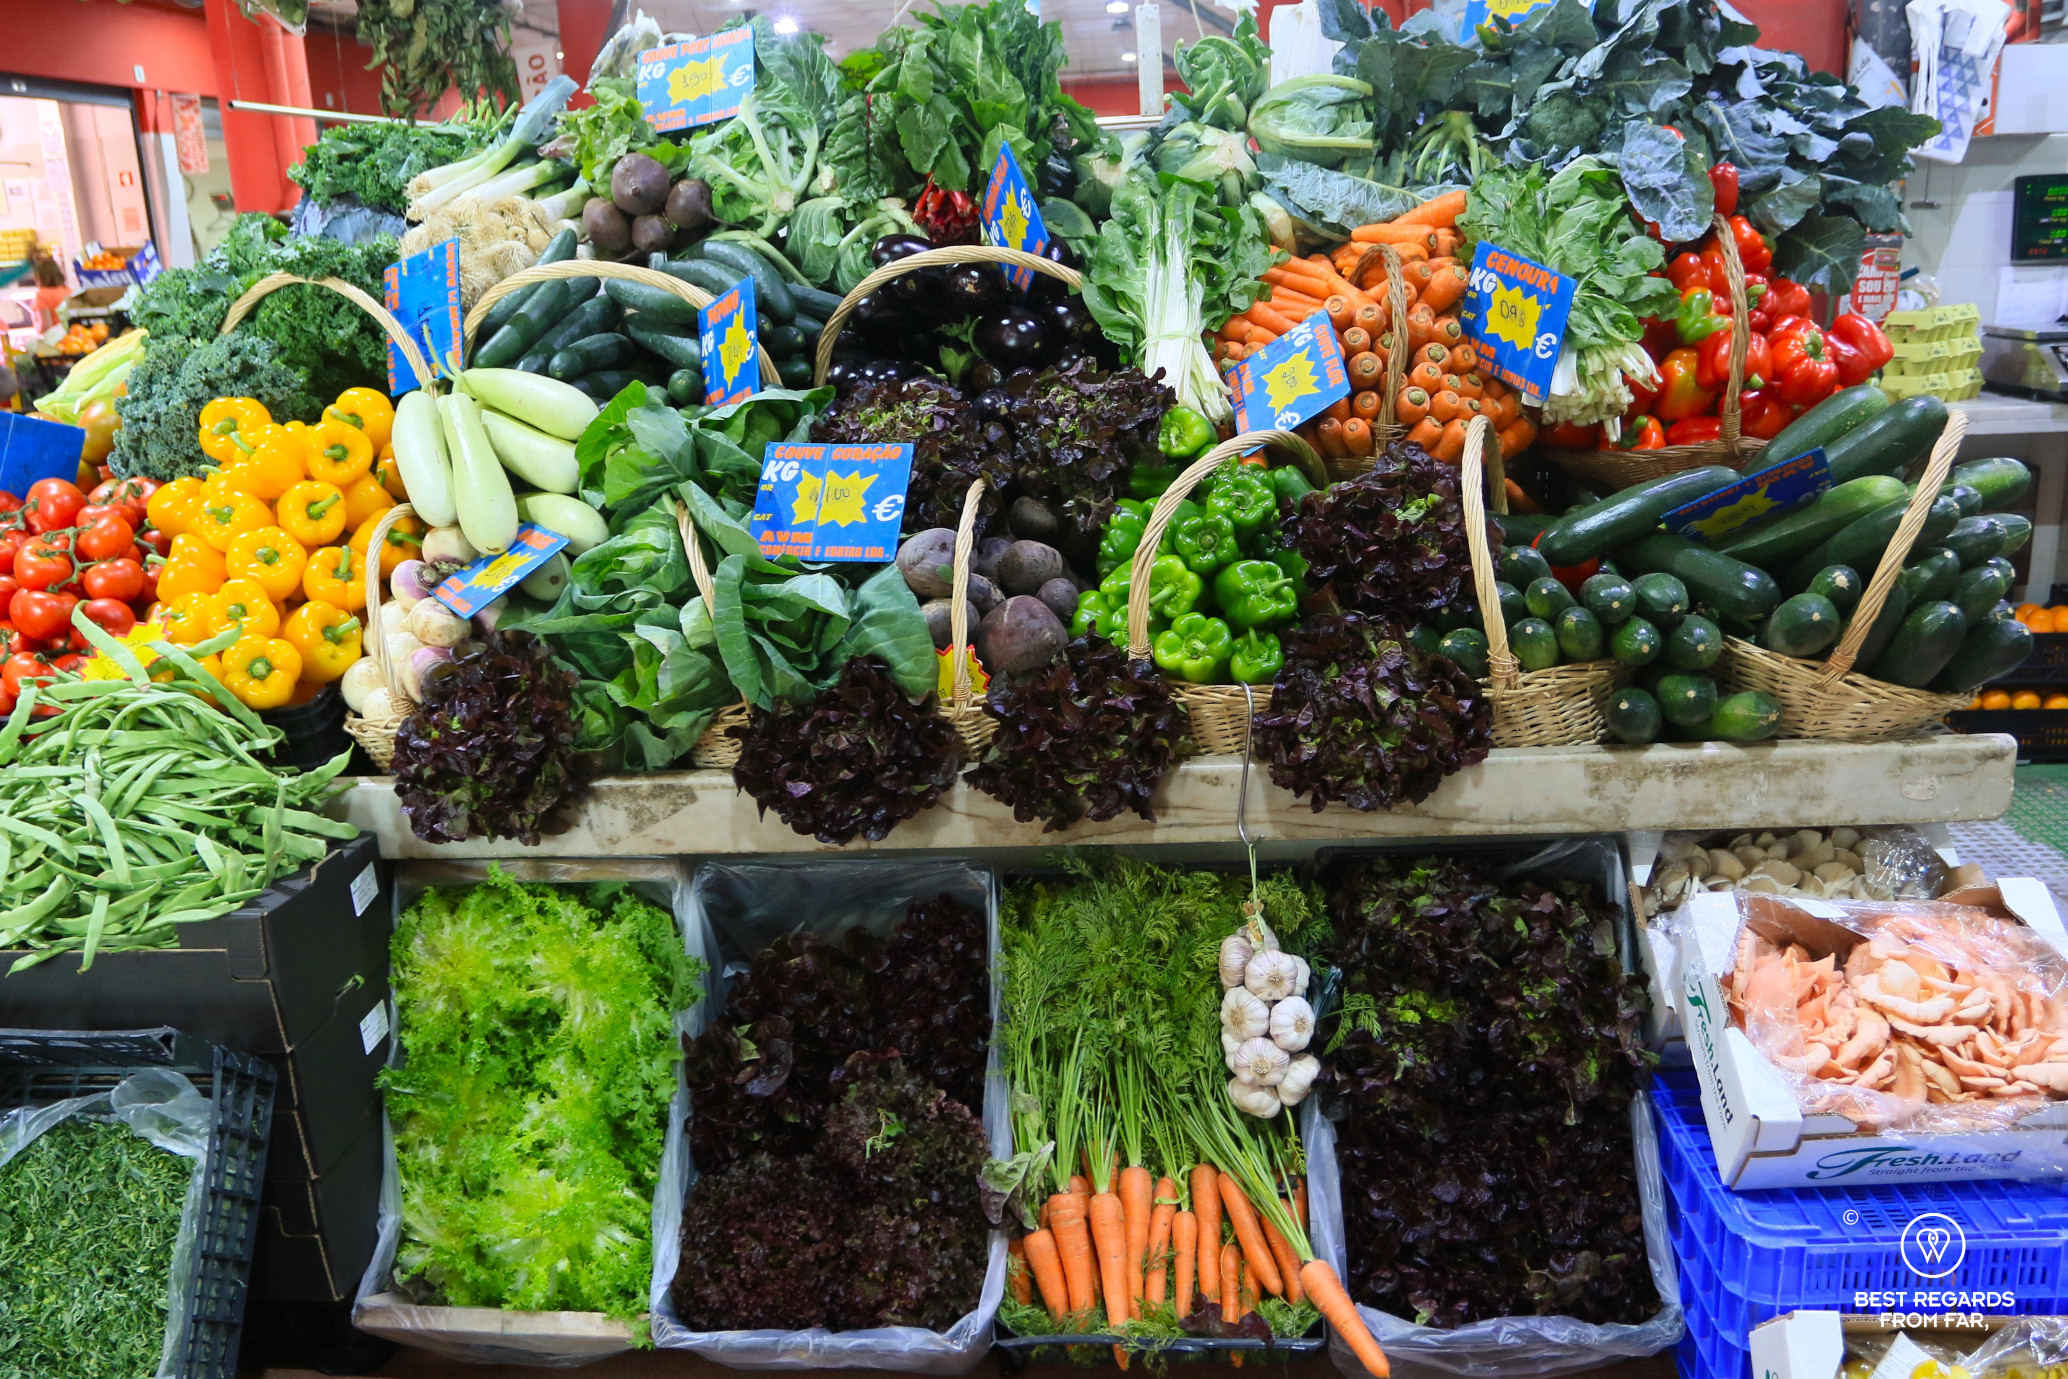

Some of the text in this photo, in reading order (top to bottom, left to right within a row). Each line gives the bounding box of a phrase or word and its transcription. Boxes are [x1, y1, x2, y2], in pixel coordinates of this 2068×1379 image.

[642, 45, 678, 64] COUVE
[638, 62, 666, 81] KG
[728, 63, 752, 87] €
[446, 242, 456, 287] COUVE
[1469, 266, 1497, 293] KG
[707, 289, 739, 328] PEPINO
[701, 330, 714, 357] KG
[1291, 322, 1313, 347] KG
[1313, 324, 1336, 359] COUVE
[1535, 332, 1558, 359] €
[1274, 410, 1300, 430] €
[775, 444, 902, 464] COUVE CORAÇÃO
[762, 460, 800, 482] KG
[753, 513, 773, 521] CAT
[872, 494, 904, 521] €
[760, 530, 813, 543] AVM
[824, 546, 862, 558] FRUTAS
[1806, 1146, 2023, 1179] Fresh.Land
[1867, 1166, 1918, 1176] Straight
[1920, 1165, 1951, 1175] from
[1953, 1164, 1972, 1172] the
